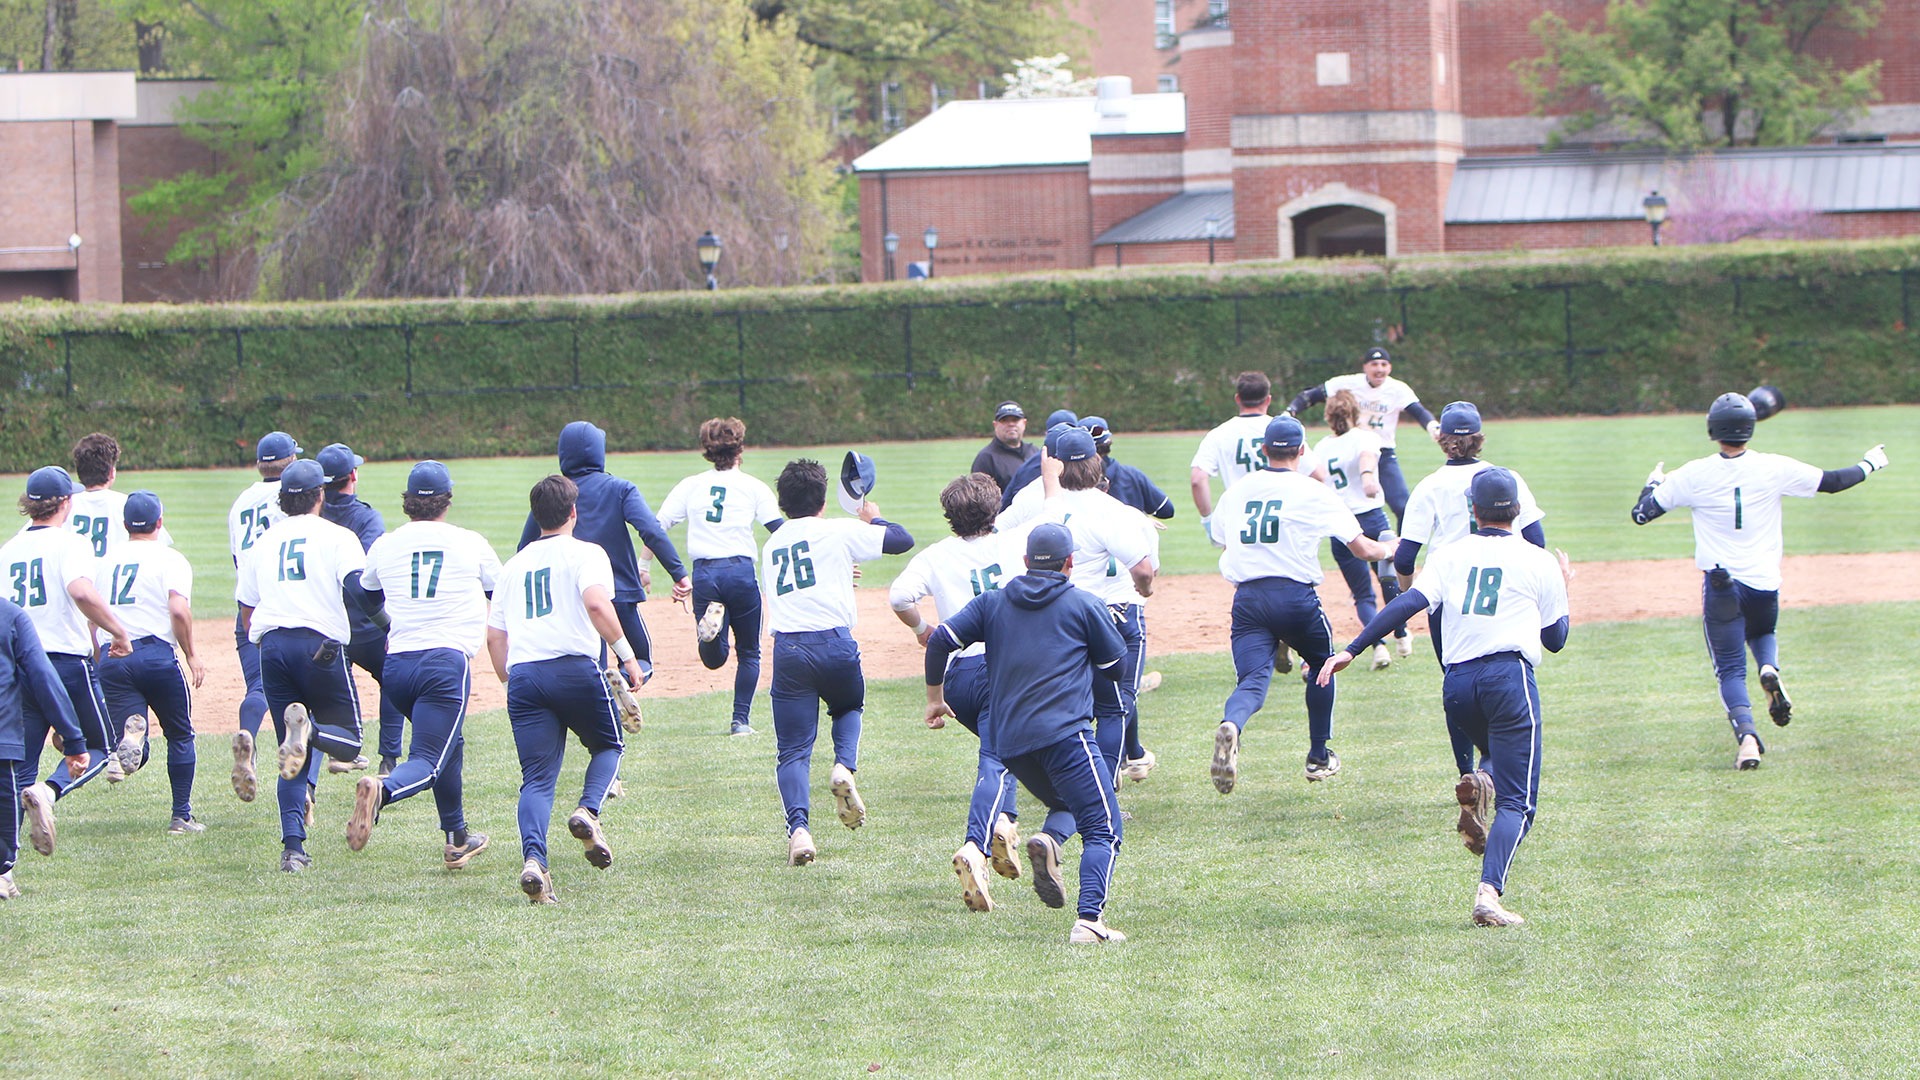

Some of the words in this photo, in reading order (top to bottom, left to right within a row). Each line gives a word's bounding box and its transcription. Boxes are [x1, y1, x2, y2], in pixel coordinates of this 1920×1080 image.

[1368, 415, 1384, 429] 44
[1236, 438, 1268, 472] 43
[1328, 457, 1348, 489] 5
[705, 485, 727, 523] 3
[1240, 500, 1283, 544] 36
[1734, 487, 1742, 529] 1
[240, 503, 270, 550] 25
[278, 538, 306, 581] 15
[411, 550, 443, 598] 17
[772, 540, 816, 596] 26
[10, 558, 47, 607] 39
[110, 564, 139, 605] 12
[524, 567, 552, 619] 10
[1462, 567, 1503, 616] 18
